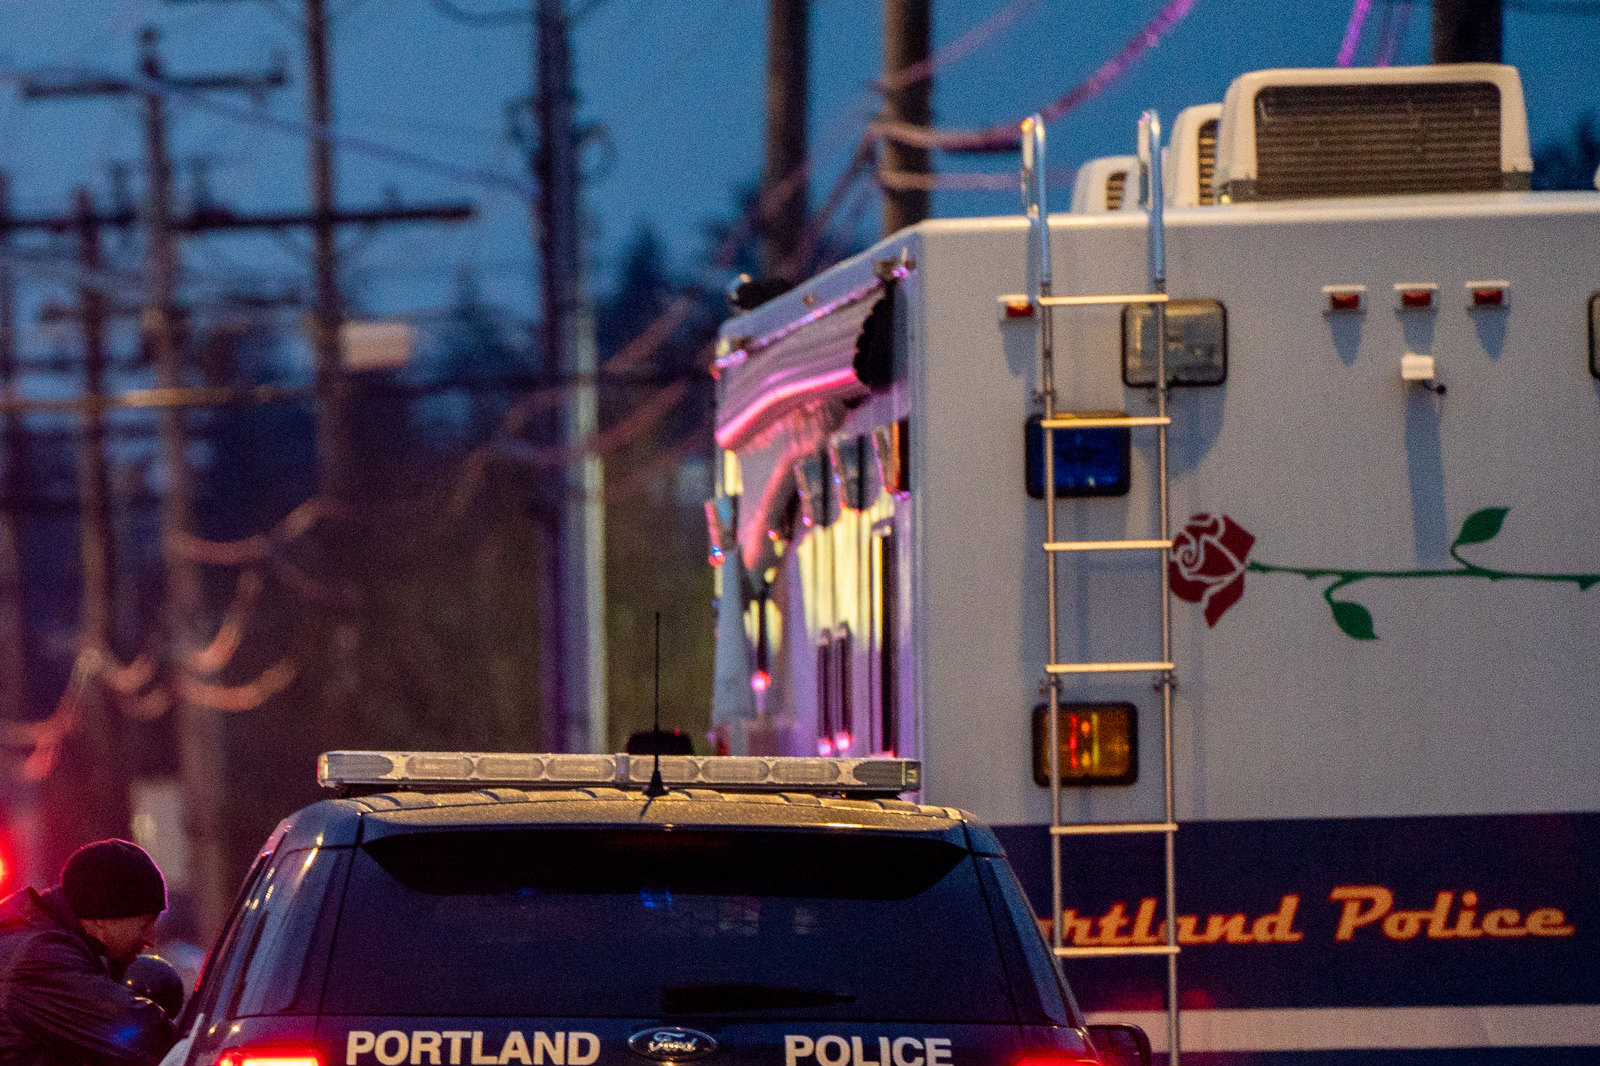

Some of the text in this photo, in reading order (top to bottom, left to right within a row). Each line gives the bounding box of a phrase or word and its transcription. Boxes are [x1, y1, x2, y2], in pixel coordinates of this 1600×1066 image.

[1327, 884, 1576, 943] Police
[345, 1030, 601, 1066] PORTLAND
[648, 1031, 698, 1053] Ford
